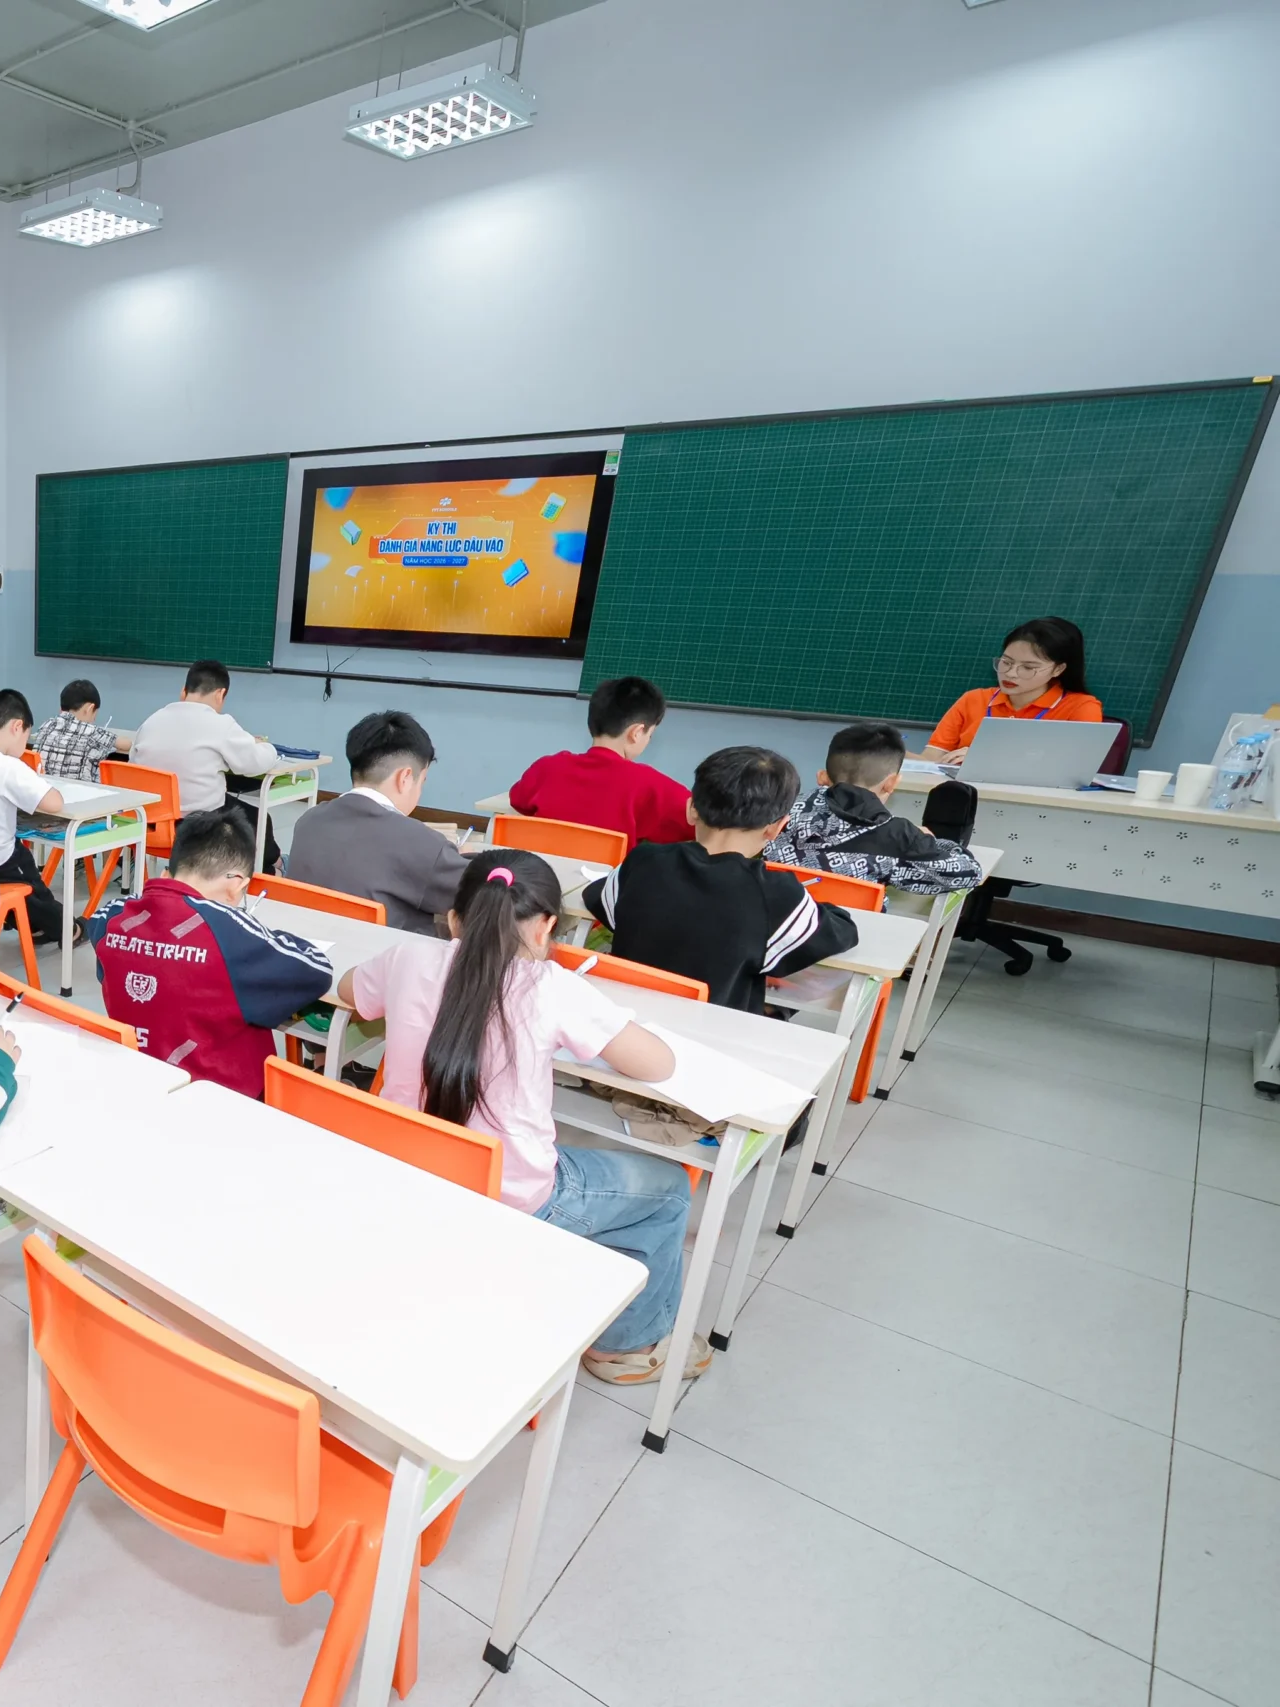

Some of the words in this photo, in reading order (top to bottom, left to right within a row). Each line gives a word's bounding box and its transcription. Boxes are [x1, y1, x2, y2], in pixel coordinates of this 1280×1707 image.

[442, 521, 457, 535] THI
[106, 933, 154, 956] CREATE
[155, 942, 207, 963] TRUTH
[132, 979, 148, 990] CR
